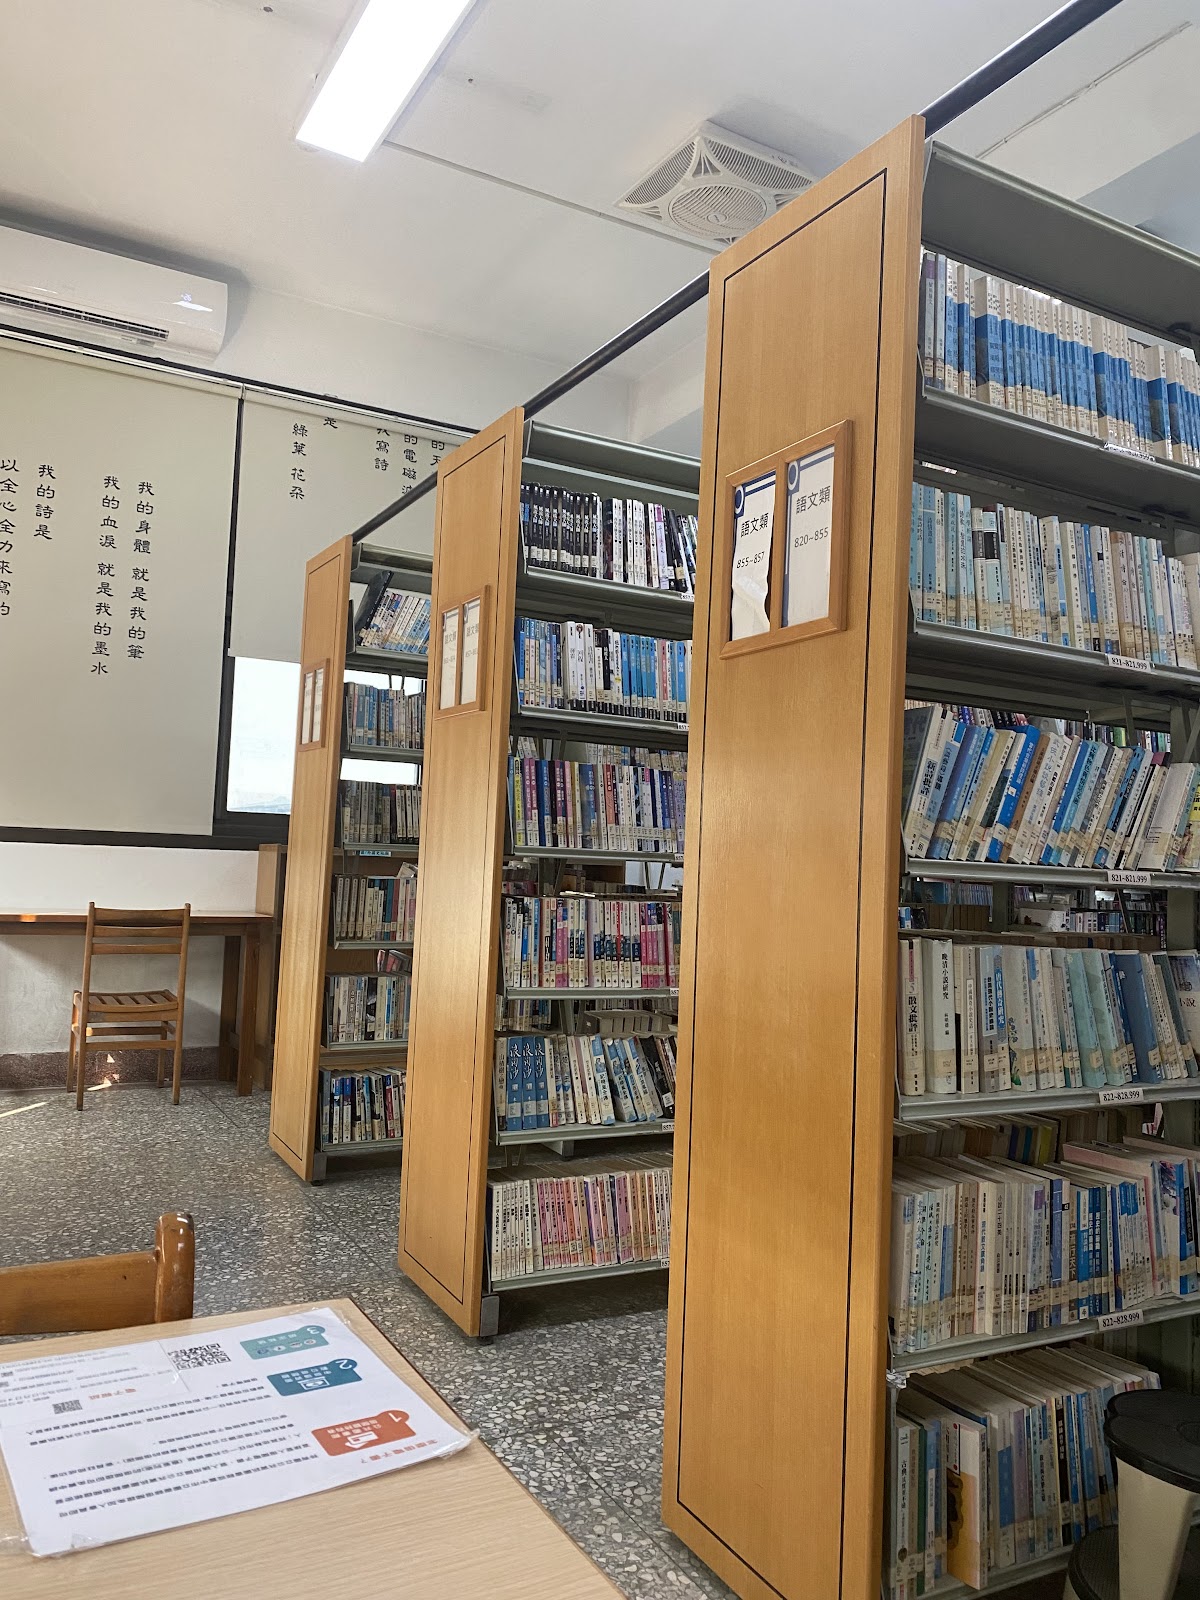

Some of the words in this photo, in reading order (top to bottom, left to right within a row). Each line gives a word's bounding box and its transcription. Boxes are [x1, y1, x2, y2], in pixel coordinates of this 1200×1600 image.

[291, 423, 309, 457] 綠葉
[289, 467, 306, 500] 花朵
[33, 463, 57, 540] 我的詩是
[99, 475, 121, 549] 我的血淚
[795, 486, 831, 514] 語文類
[133, 481, 155, 554] 我的身體
[740, 513, 769, 538] 語文類
[794, 527, 830, 548] 820~855
[736, 551, 765, 569] 855~857
[90, 562, 116, 676] 就是我的墨水
[127, 567, 150, 659] 就是我的筆
[1111, 873, 1148, 883] 821~821.999
[1102, 1311, 1140, 1329] 822~828.999
[335, 1359, 353, 1369] 2
[388, 1412, 402, 1422] 1
